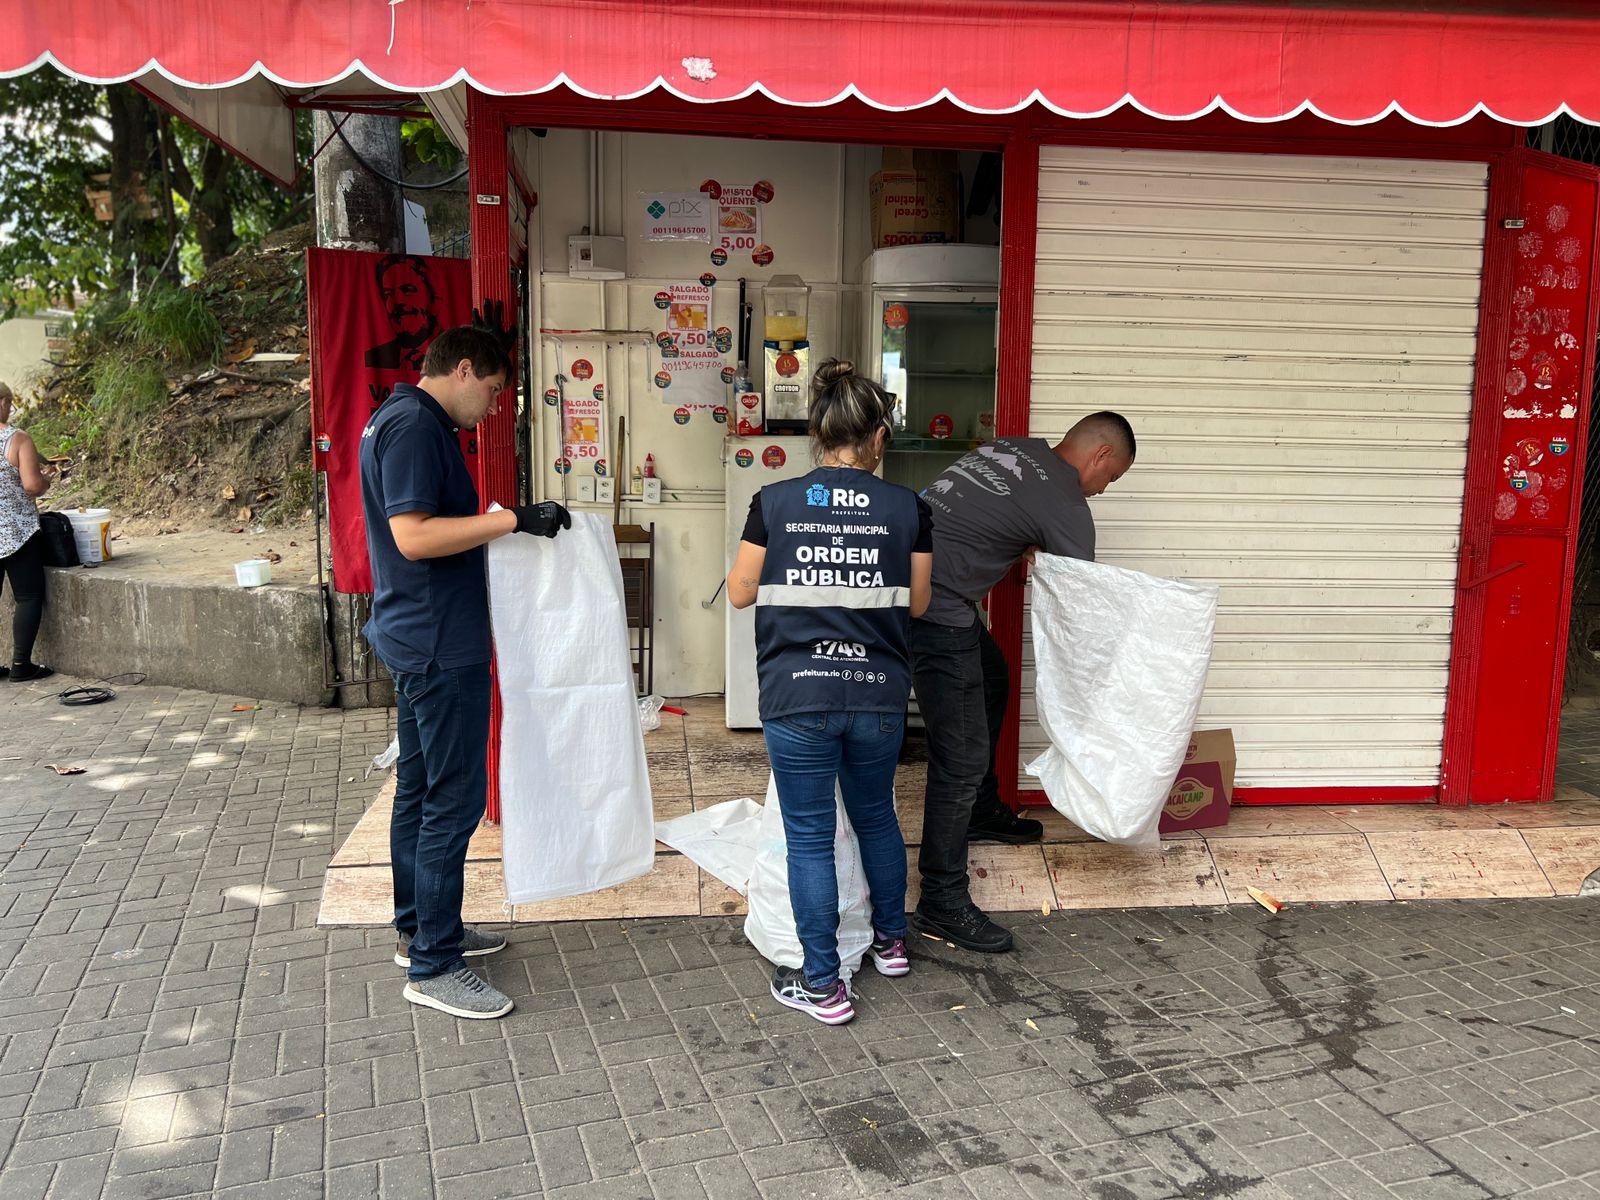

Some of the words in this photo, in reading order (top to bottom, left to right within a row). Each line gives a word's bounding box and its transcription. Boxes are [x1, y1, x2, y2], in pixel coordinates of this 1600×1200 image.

[722, 188, 752, 196] MISTO
[720, 196, 755, 206] QUENTE
[885, 195, 924, 206] Matinal
[668, 199, 702, 218] pix
[894, 208, 928, 218] Cereal
[721, 237, 755, 251] 5,00
[672, 332, 706, 346] 7,50
[564, 446, 598, 459] 6,50
[832, 488, 870, 508] Rio
[786, 523, 841, 534] SECRETARIA
[843, 524, 889, 535] MUNICIPAL
[832, 536, 844, 546] DE
[796, 546, 879, 565] ORDEM
[786, 566, 884, 587] PÚBLICA
[792, 669, 840, 680] prefeitura.rio
